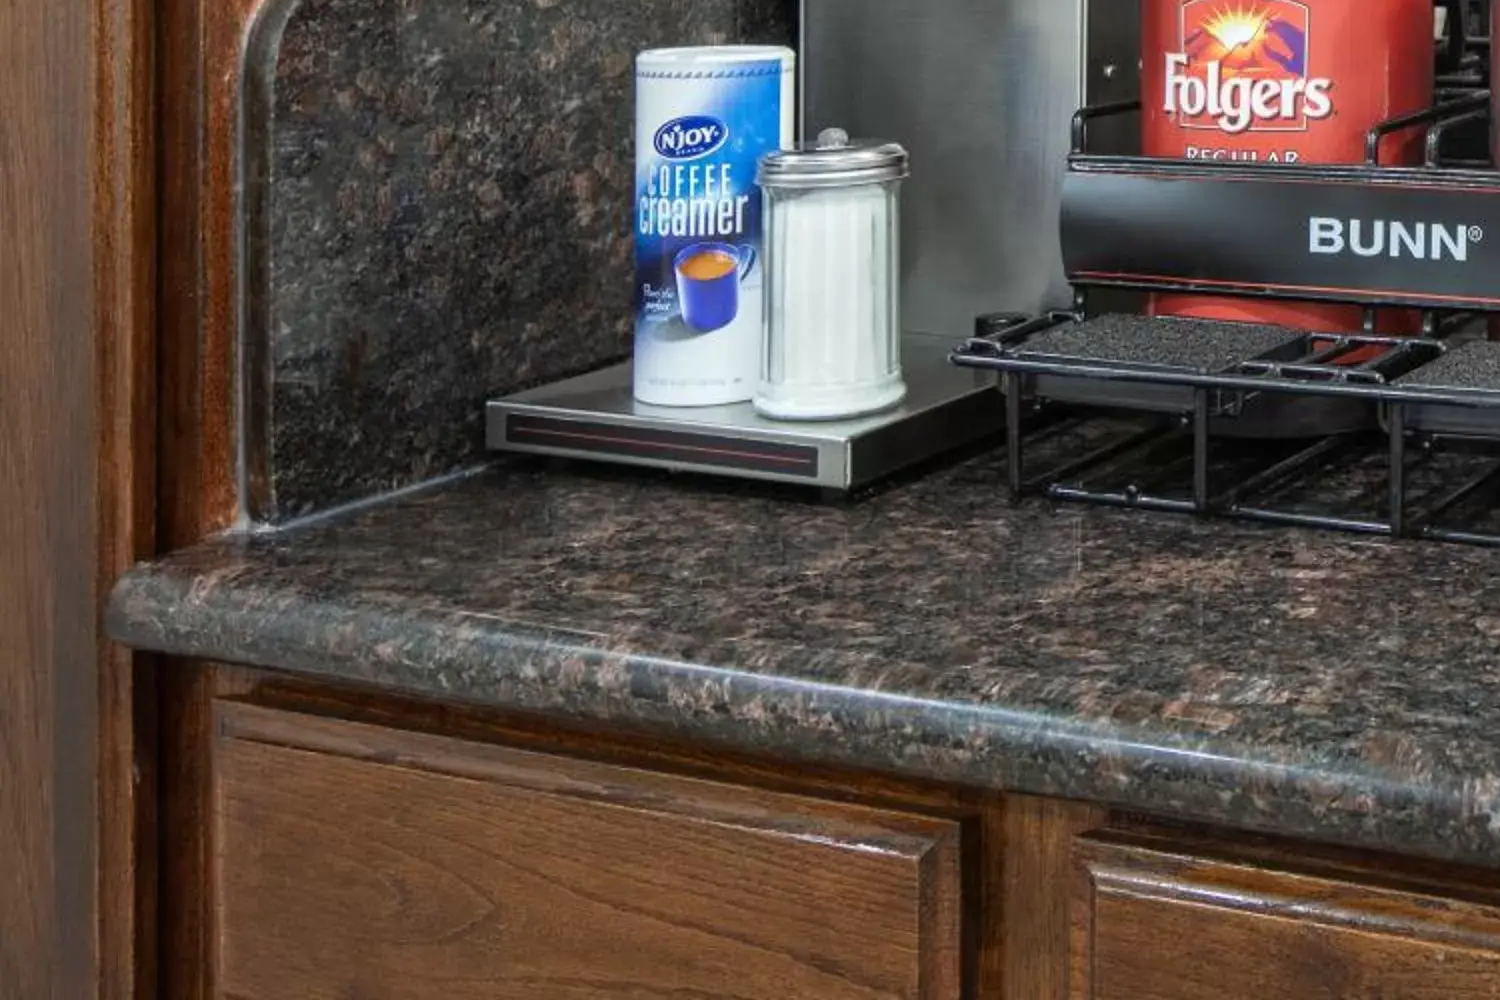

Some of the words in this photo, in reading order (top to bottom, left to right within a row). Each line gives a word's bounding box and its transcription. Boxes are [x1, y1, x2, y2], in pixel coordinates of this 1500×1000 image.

[1163, 53, 1332, 133] Folgers
[648, 164, 732, 197] COFFEE
[639, 195, 749, 237] creamer
